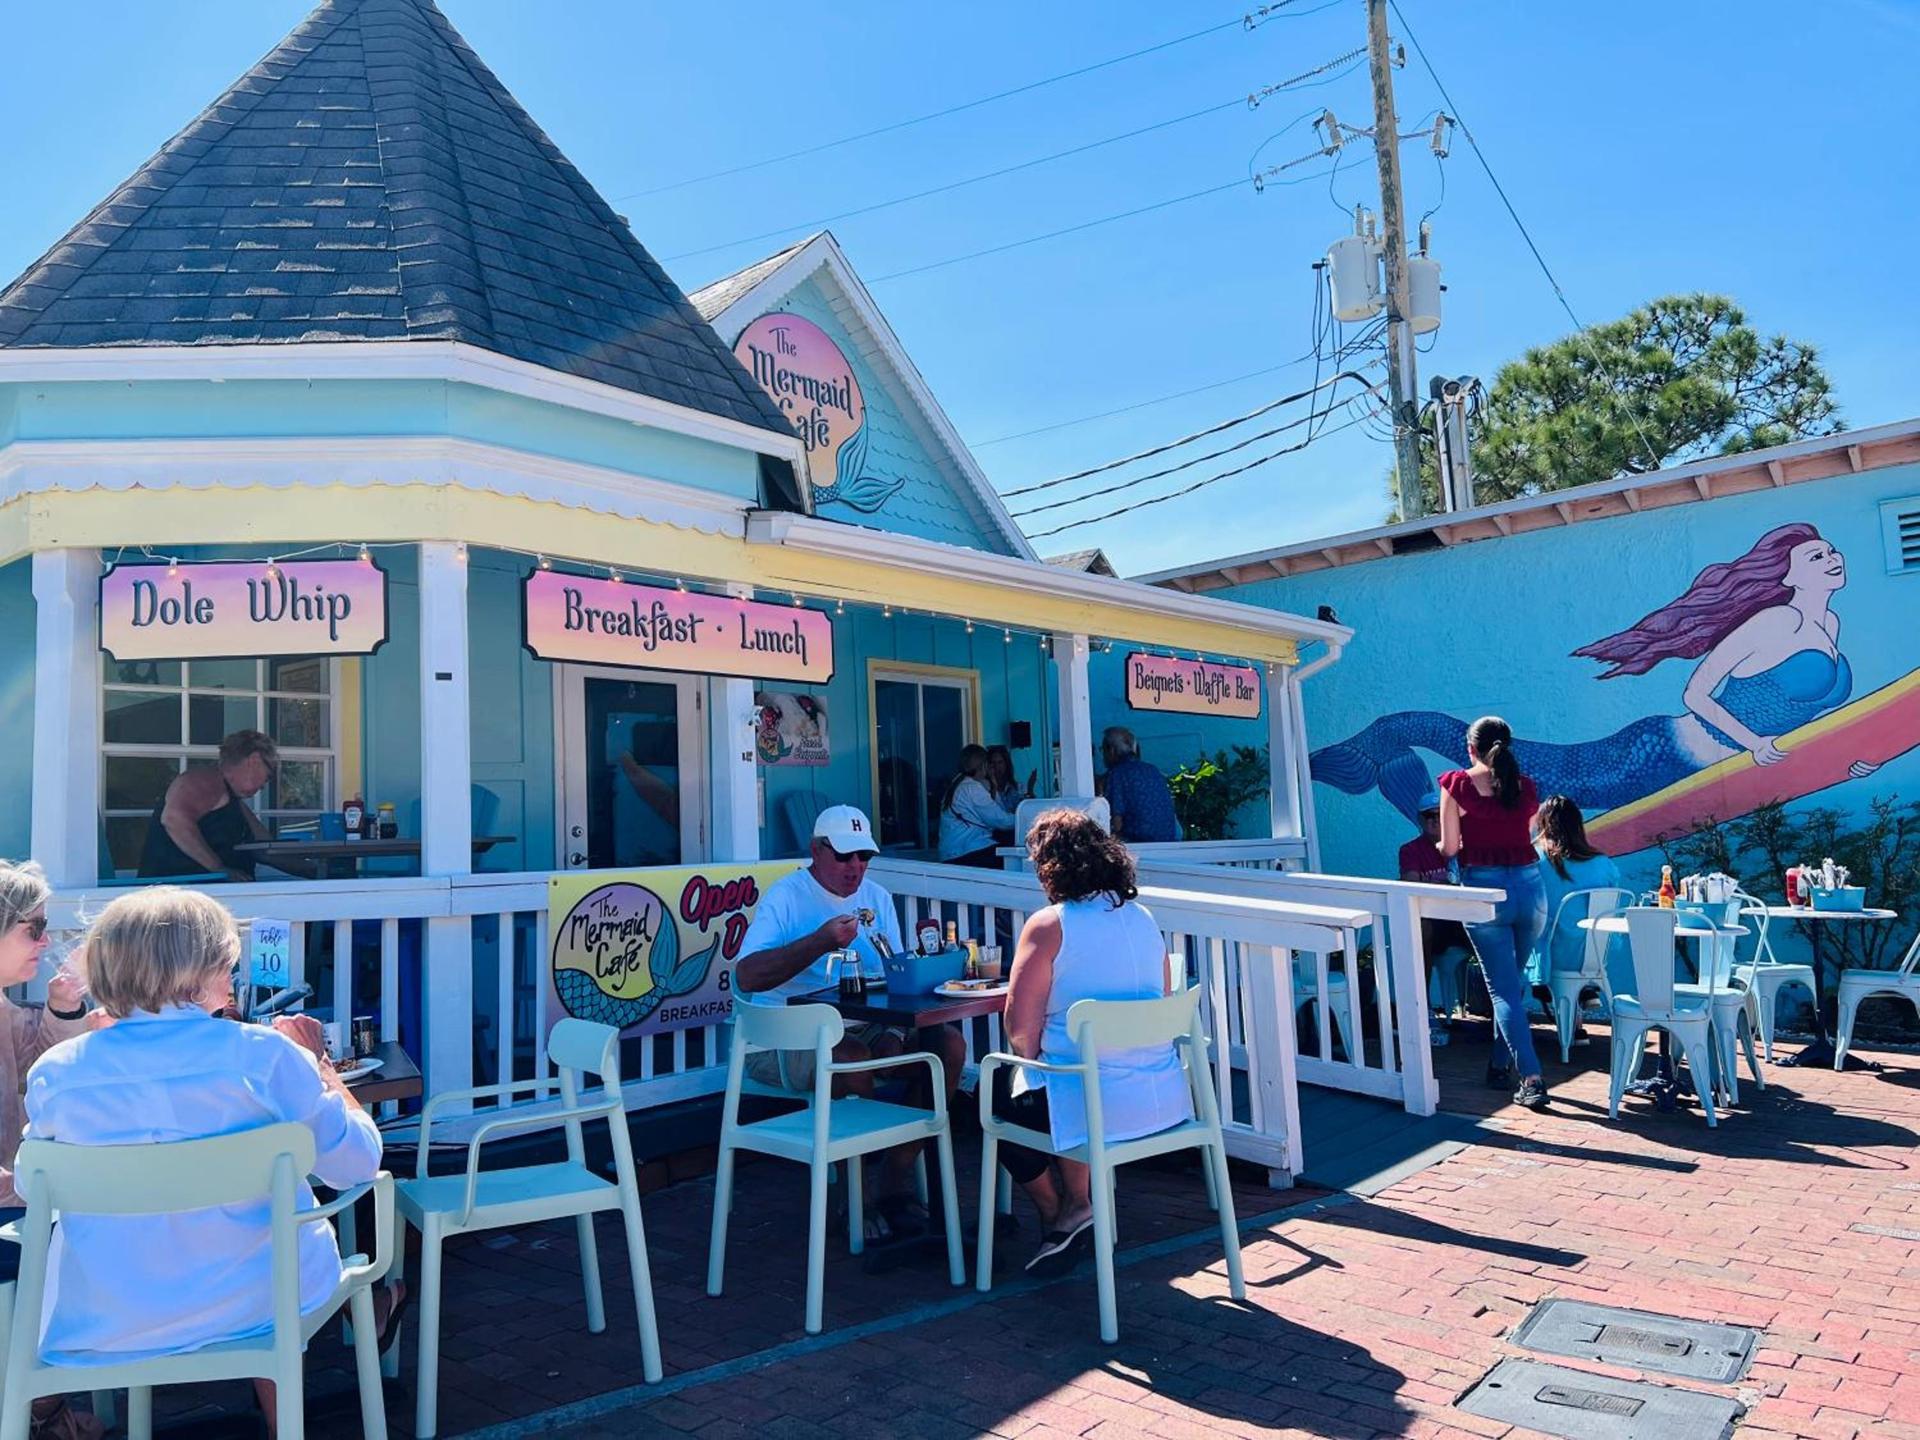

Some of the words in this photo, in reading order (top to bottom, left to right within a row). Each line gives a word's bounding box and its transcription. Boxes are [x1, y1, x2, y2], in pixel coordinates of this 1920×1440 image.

[768, 327, 798, 356] The
[748, 344, 854, 420] Mermaid
[131, 578, 215, 627] Dole
[246, 569, 352, 641] Whip
[563, 586, 704, 652] Breakfast
[739, 612, 808, 666] Lunch
[1135, 663, 1184, 704] Beignets
[1193, 665, 1231, 704] Waffle
[1235, 675, 1255, 700] Bar
[851, 819, 862, 831] H
[590, 892, 619, 918] The
[680, 875, 760, 933] Open
[570, 903, 651, 951] Mermaid
[721, 912, 749, 961] D
[260, 952, 281, 972] 10
[718, 970, 731, 992] 8
[660, 1000, 732, 1022] BREAKFAS
